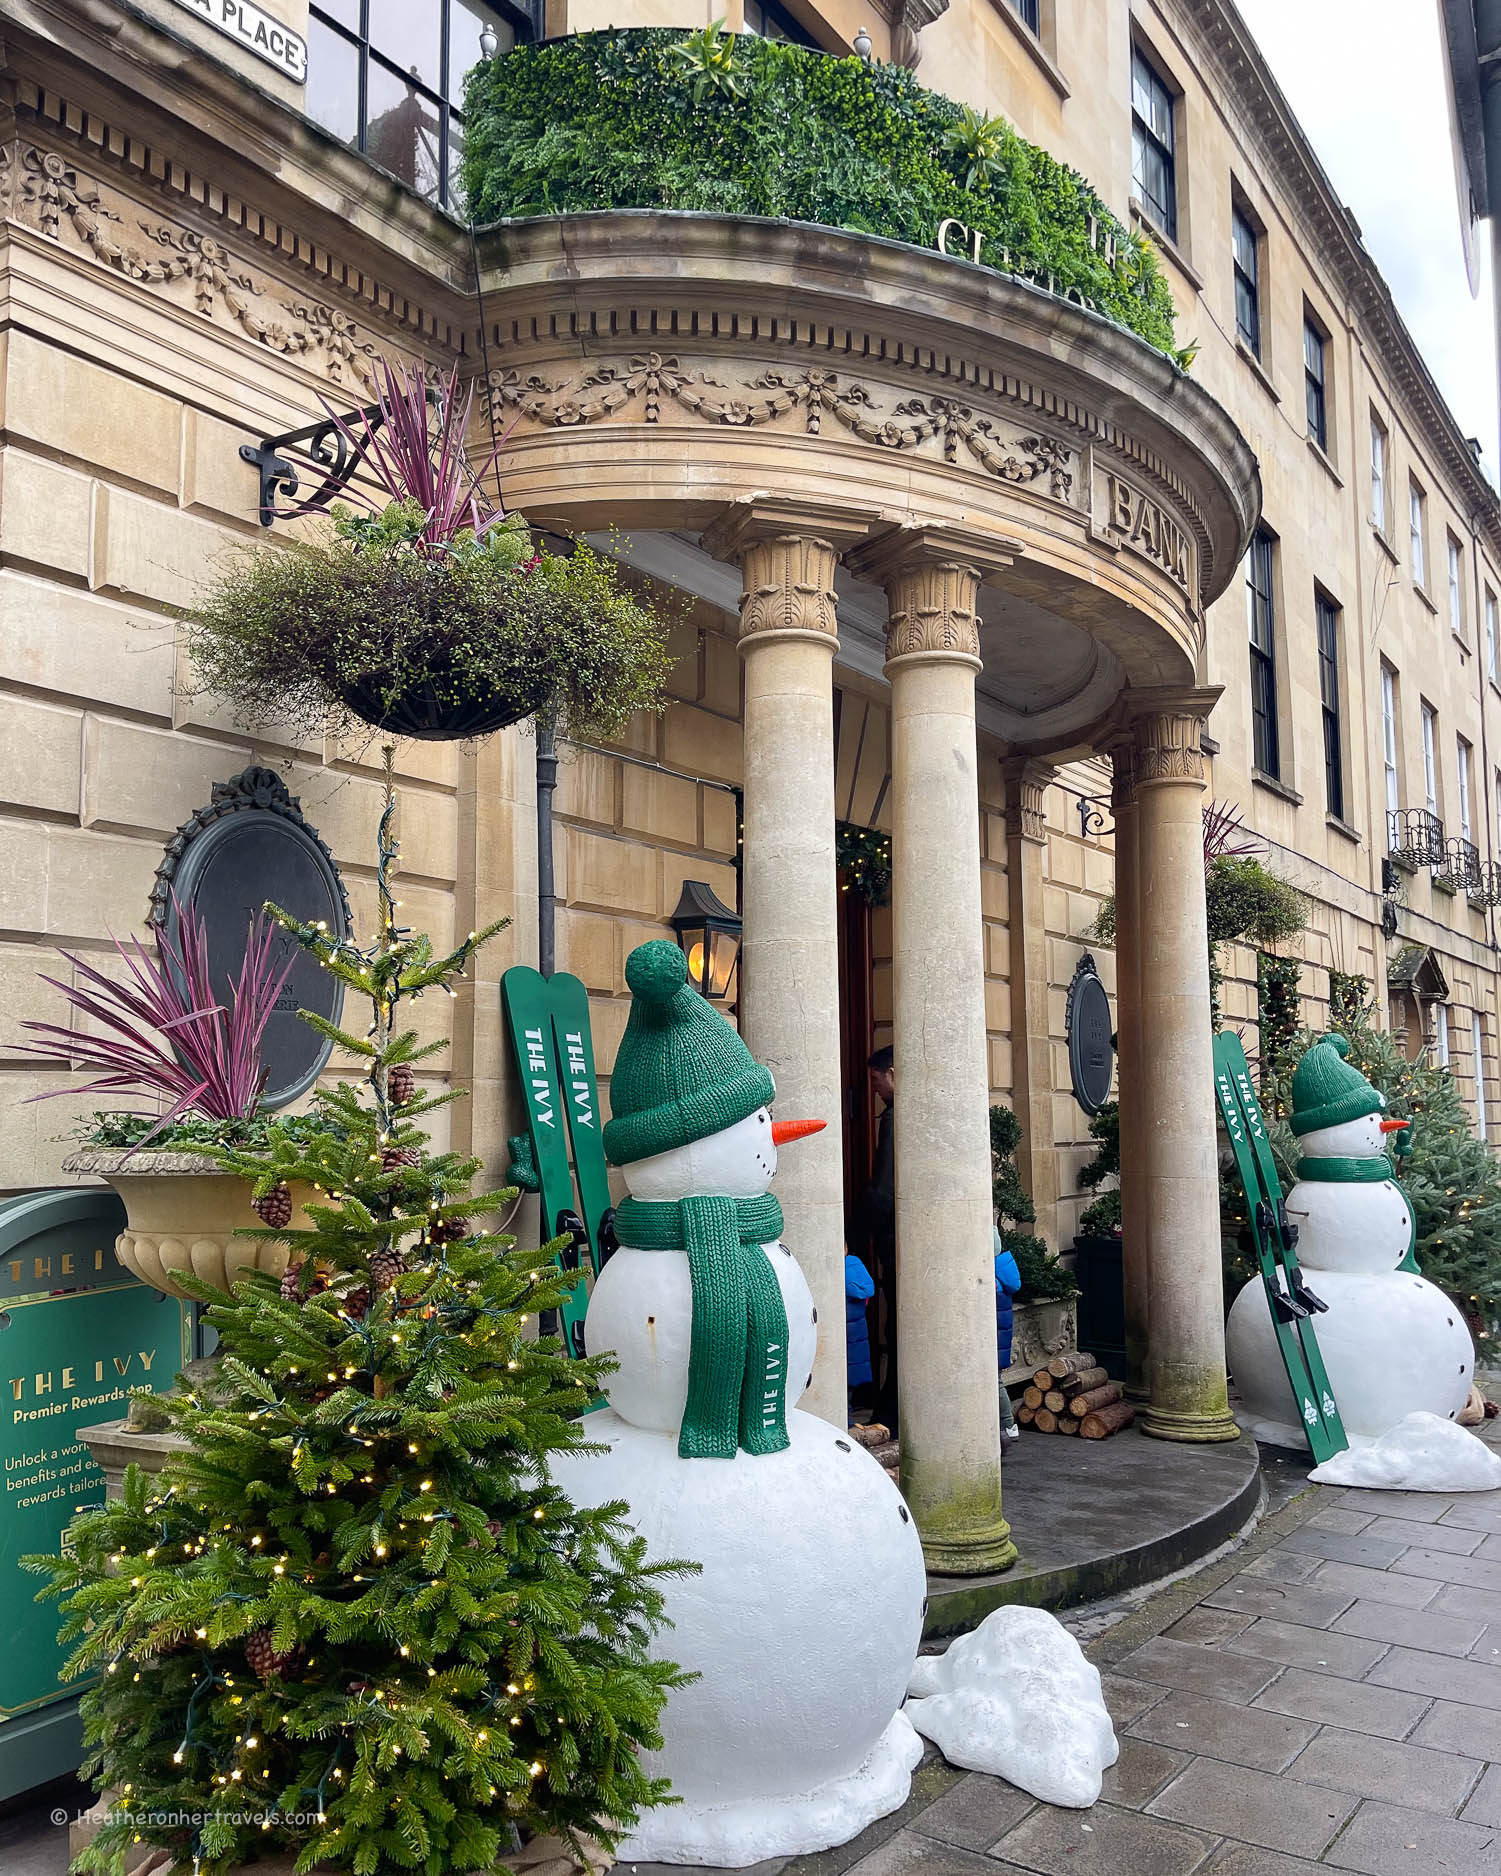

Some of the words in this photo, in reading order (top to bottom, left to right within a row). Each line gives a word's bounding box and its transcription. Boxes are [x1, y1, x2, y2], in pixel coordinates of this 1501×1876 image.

[221, 0, 299, 70] PLACE
[1107, 475, 1190, 587] BANK
[525, 1027, 547, 1072] THE
[565, 1031, 587, 1075] THE
[531, 1079, 555, 1129] IVY
[572, 1081, 594, 1129] IVY
[1217, 1073, 1233, 1105] THE
[1227, 1109, 1243, 1143] IVY
[1237, 1071, 1253, 1103] THE
[1247, 1107, 1264, 1140] IVY
[8, 1253, 75, 1281] THE
[8, 1366, 77, 1401] THE
[95, 1349, 156, 1382] IVY
[765, 1342, 781, 1380] IVY
[13, 1402, 69, 1424] Premier
[71, 1387, 126, 1410] Rewards
[762, 1389, 778, 1429] THE
[5, 1449, 48, 1470] Unlock
[51, 1451, 58, 1460] a
[61, 1442, 90, 1457] worl
[6, 1469, 57, 1491] benefits
[60, 1459, 82, 1477] and
[17, 1485, 66, 1509] rewards
[69, 1476, 108, 1494] tailore
